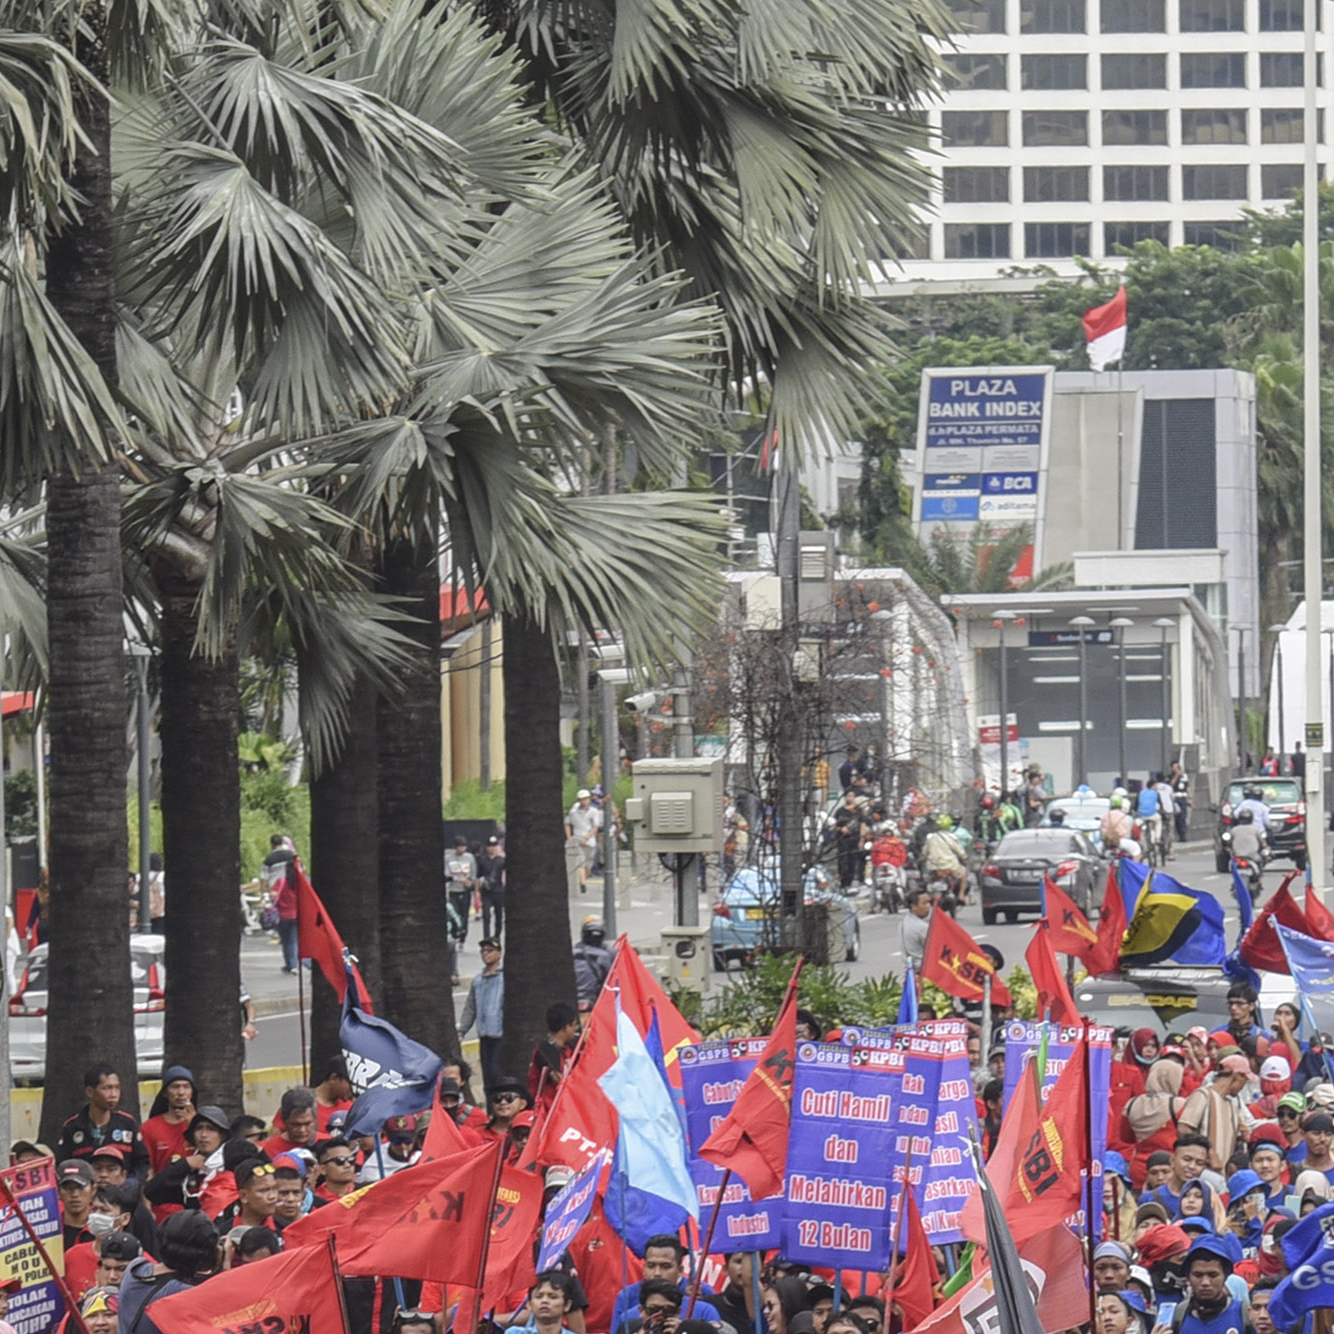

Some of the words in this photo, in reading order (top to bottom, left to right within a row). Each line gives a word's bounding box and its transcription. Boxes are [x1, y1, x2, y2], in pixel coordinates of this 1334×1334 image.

[951, 380, 1016, 396] PLAZA
[930, 402, 980, 417] BANK
[986, 401, 1041, 416] INDEX
[947, 426, 983, 435] PLAZA
[985, 425, 1039, 434] PERMATA
[1003, 477, 1032, 489] BCA
[817, 1050, 850, 1064] GSPB
[871, 1050, 904, 1069] KPBI
[800, 1087, 837, 1117] Cuti
[840, 1091, 892, 1122] Hamil
[824, 1136, 859, 1164] dan
[790, 1174, 887, 1211] Melahirkan
[798, 1219, 819, 1247] 12
[821, 1221, 872, 1253] Bulan
[4, 1244, 37, 1266] CABU
